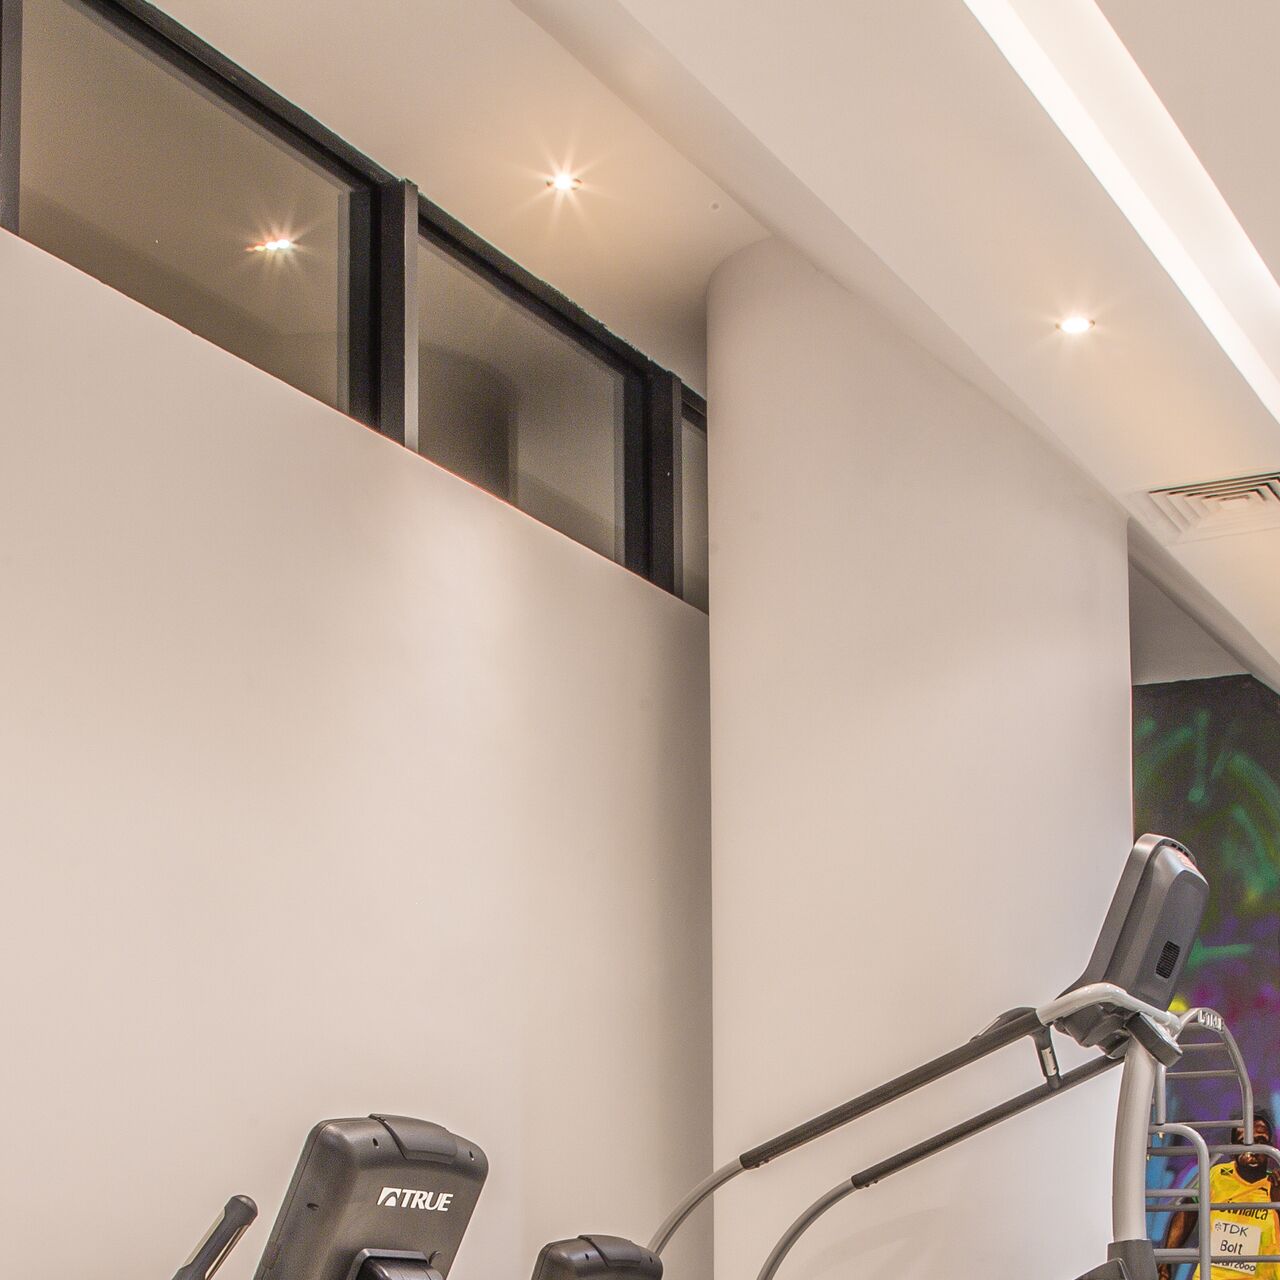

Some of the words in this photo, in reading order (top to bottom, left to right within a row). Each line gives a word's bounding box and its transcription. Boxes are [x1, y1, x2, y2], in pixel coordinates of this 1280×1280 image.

[401, 1188, 454, 1212] TRUE
[1221, 1222, 1249, 1237] TDK
[1220, 1239, 1243, 1256] Bolt
